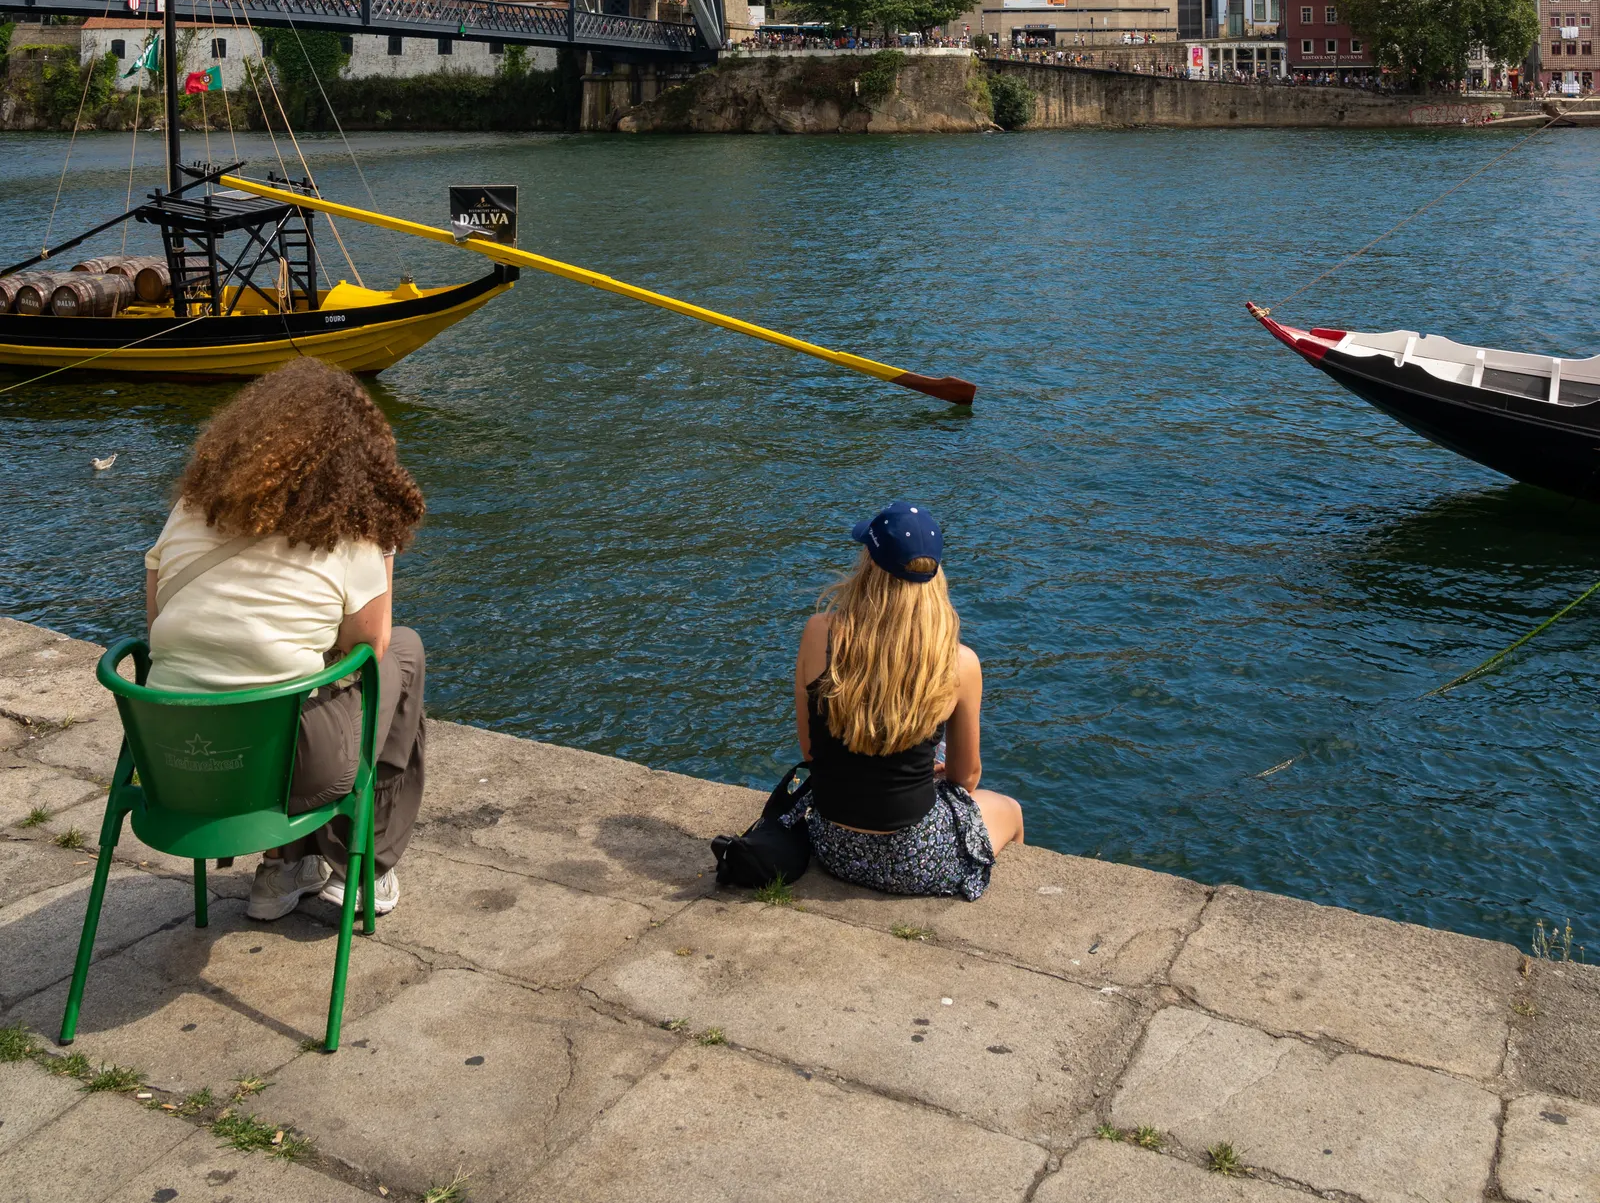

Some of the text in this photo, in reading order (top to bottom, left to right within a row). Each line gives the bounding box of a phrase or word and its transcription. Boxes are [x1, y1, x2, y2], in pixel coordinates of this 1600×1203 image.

[460, 213, 509, 225] DALVA
[21, 298, 39, 308] DALVA
[57, 300, 76, 308] DALVA
[324, 314, 346, 324] DOURO
[164, 753, 244, 771] Heineken
